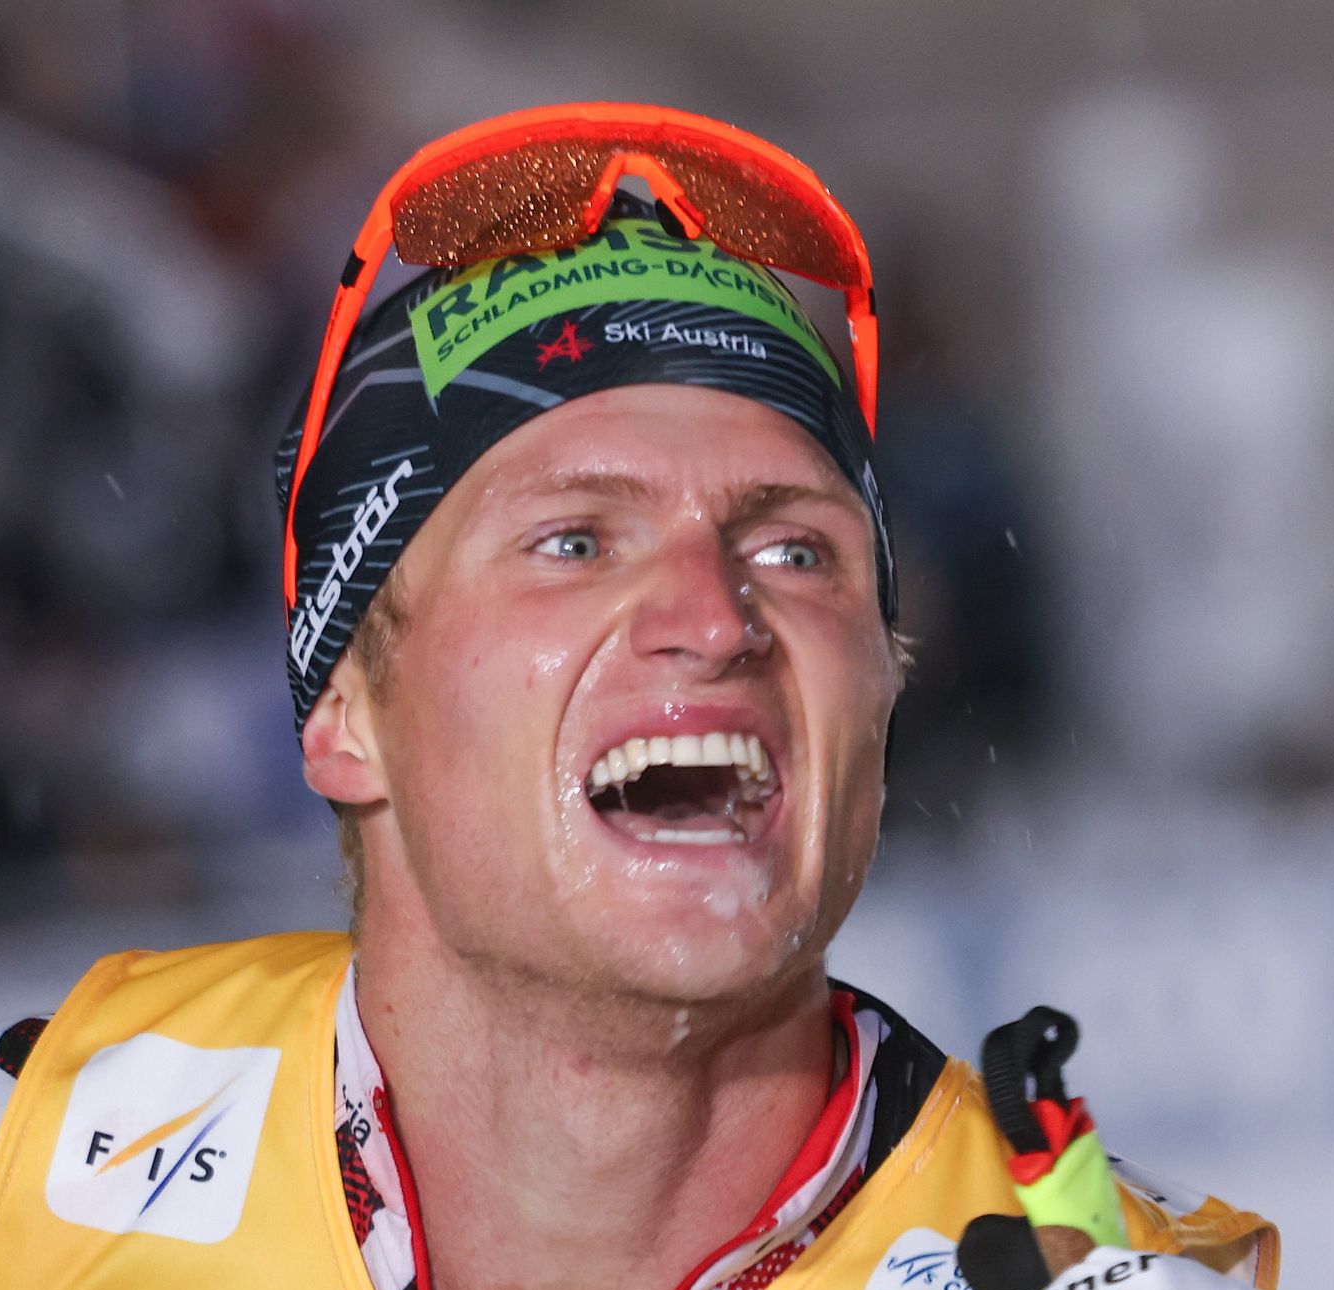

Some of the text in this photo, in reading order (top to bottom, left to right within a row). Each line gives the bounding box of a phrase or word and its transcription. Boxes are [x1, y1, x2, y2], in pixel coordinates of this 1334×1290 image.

[604, 321, 767, 360] Ski Austria
[85, 1129, 219, 1184] FIS
